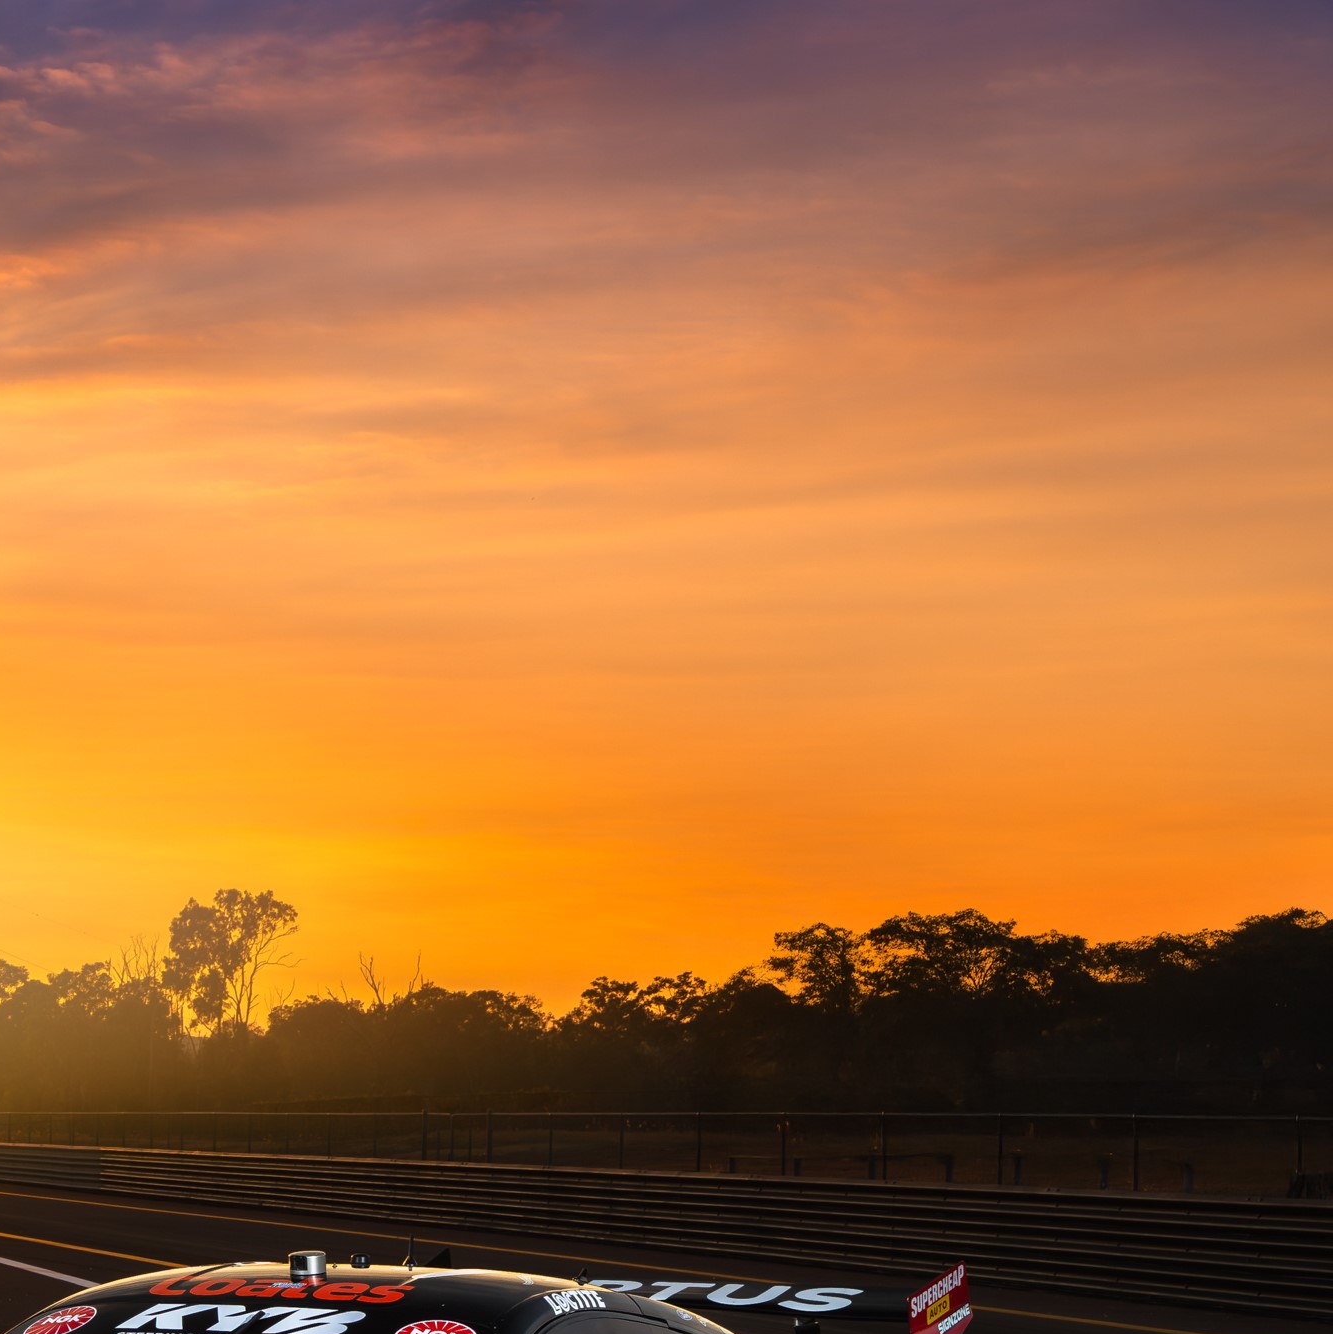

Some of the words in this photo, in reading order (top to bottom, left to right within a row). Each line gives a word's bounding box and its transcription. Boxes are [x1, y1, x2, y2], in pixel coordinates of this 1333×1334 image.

[149, 1273, 415, 1304] Coates
[543, 1290, 607, 1315] LOCTITE
[589, 1280, 864, 1312] PTUS
[911, 1264, 965, 1318] SUPERCHEAP
[42, 1312, 84, 1326] NGK
[929, 1300, 948, 1319] AUTO
[937, 1303, 971, 1334] SIGNZONE
